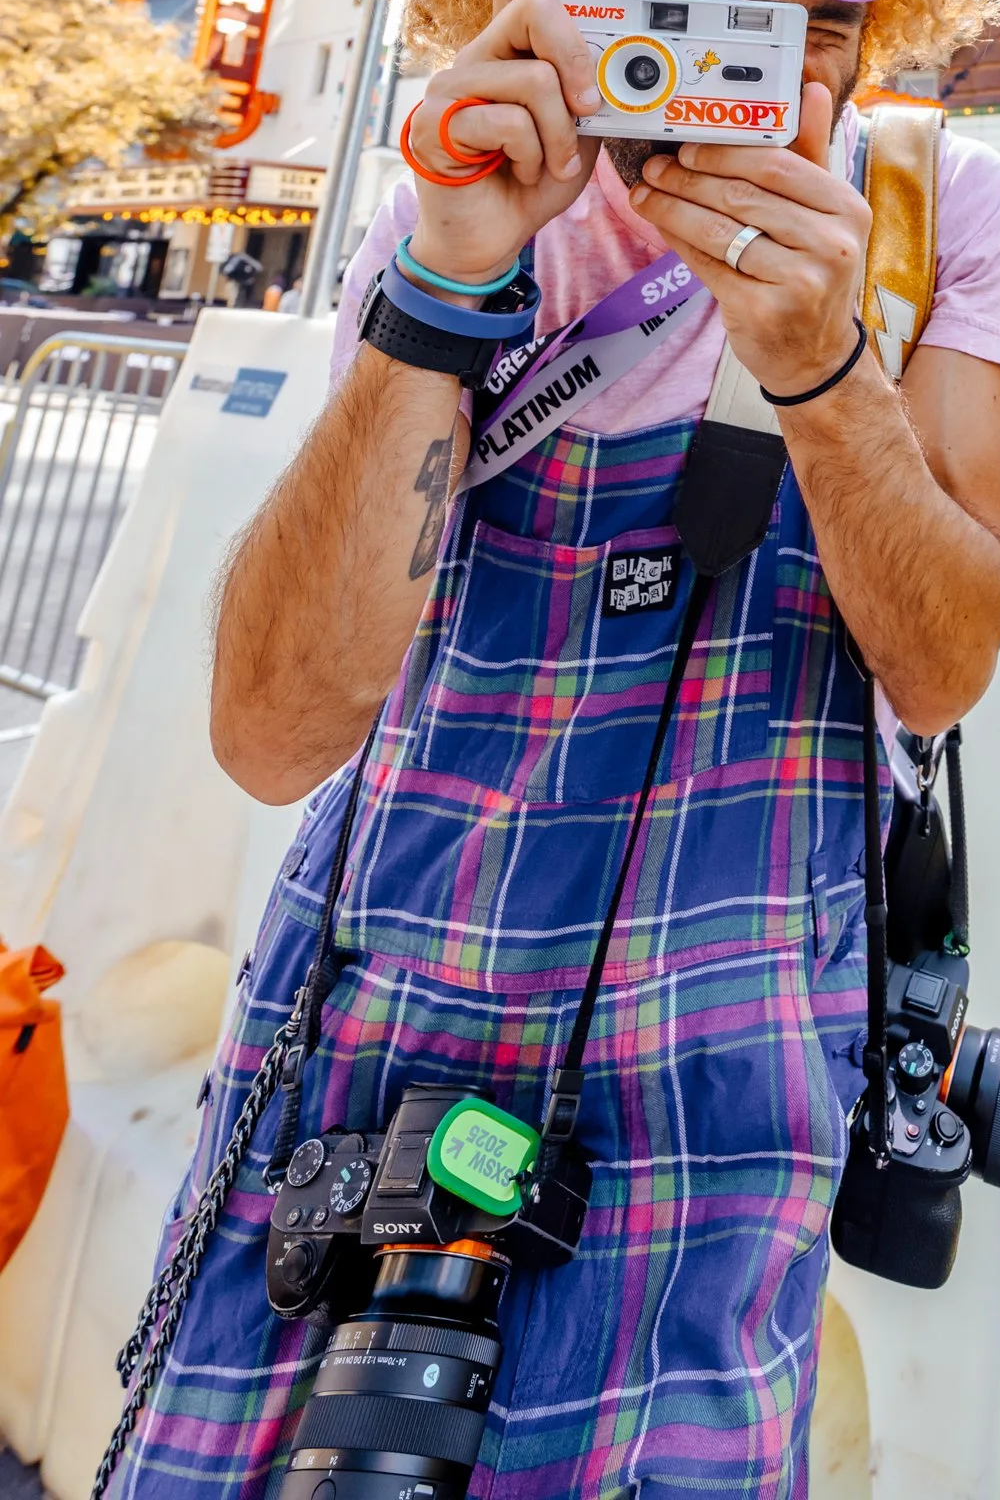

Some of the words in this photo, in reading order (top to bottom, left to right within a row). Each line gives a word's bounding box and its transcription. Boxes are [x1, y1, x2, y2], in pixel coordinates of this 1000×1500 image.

[664, 100, 789, 128] SNOOPY
[641, 262, 692, 305] SXS
[476, 354, 602, 465] PLATINUM
[612, 555, 673, 582] BLACK
[609, 580, 673, 609] FRIDAY
[951, 999, 964, 1040] SONY
[465, 1124, 508, 1158] 2025
[467, 1151, 514, 1187] SXSW
[315, 1212, 326, 1220] C2
[373, 1223, 423, 1234] SONY
